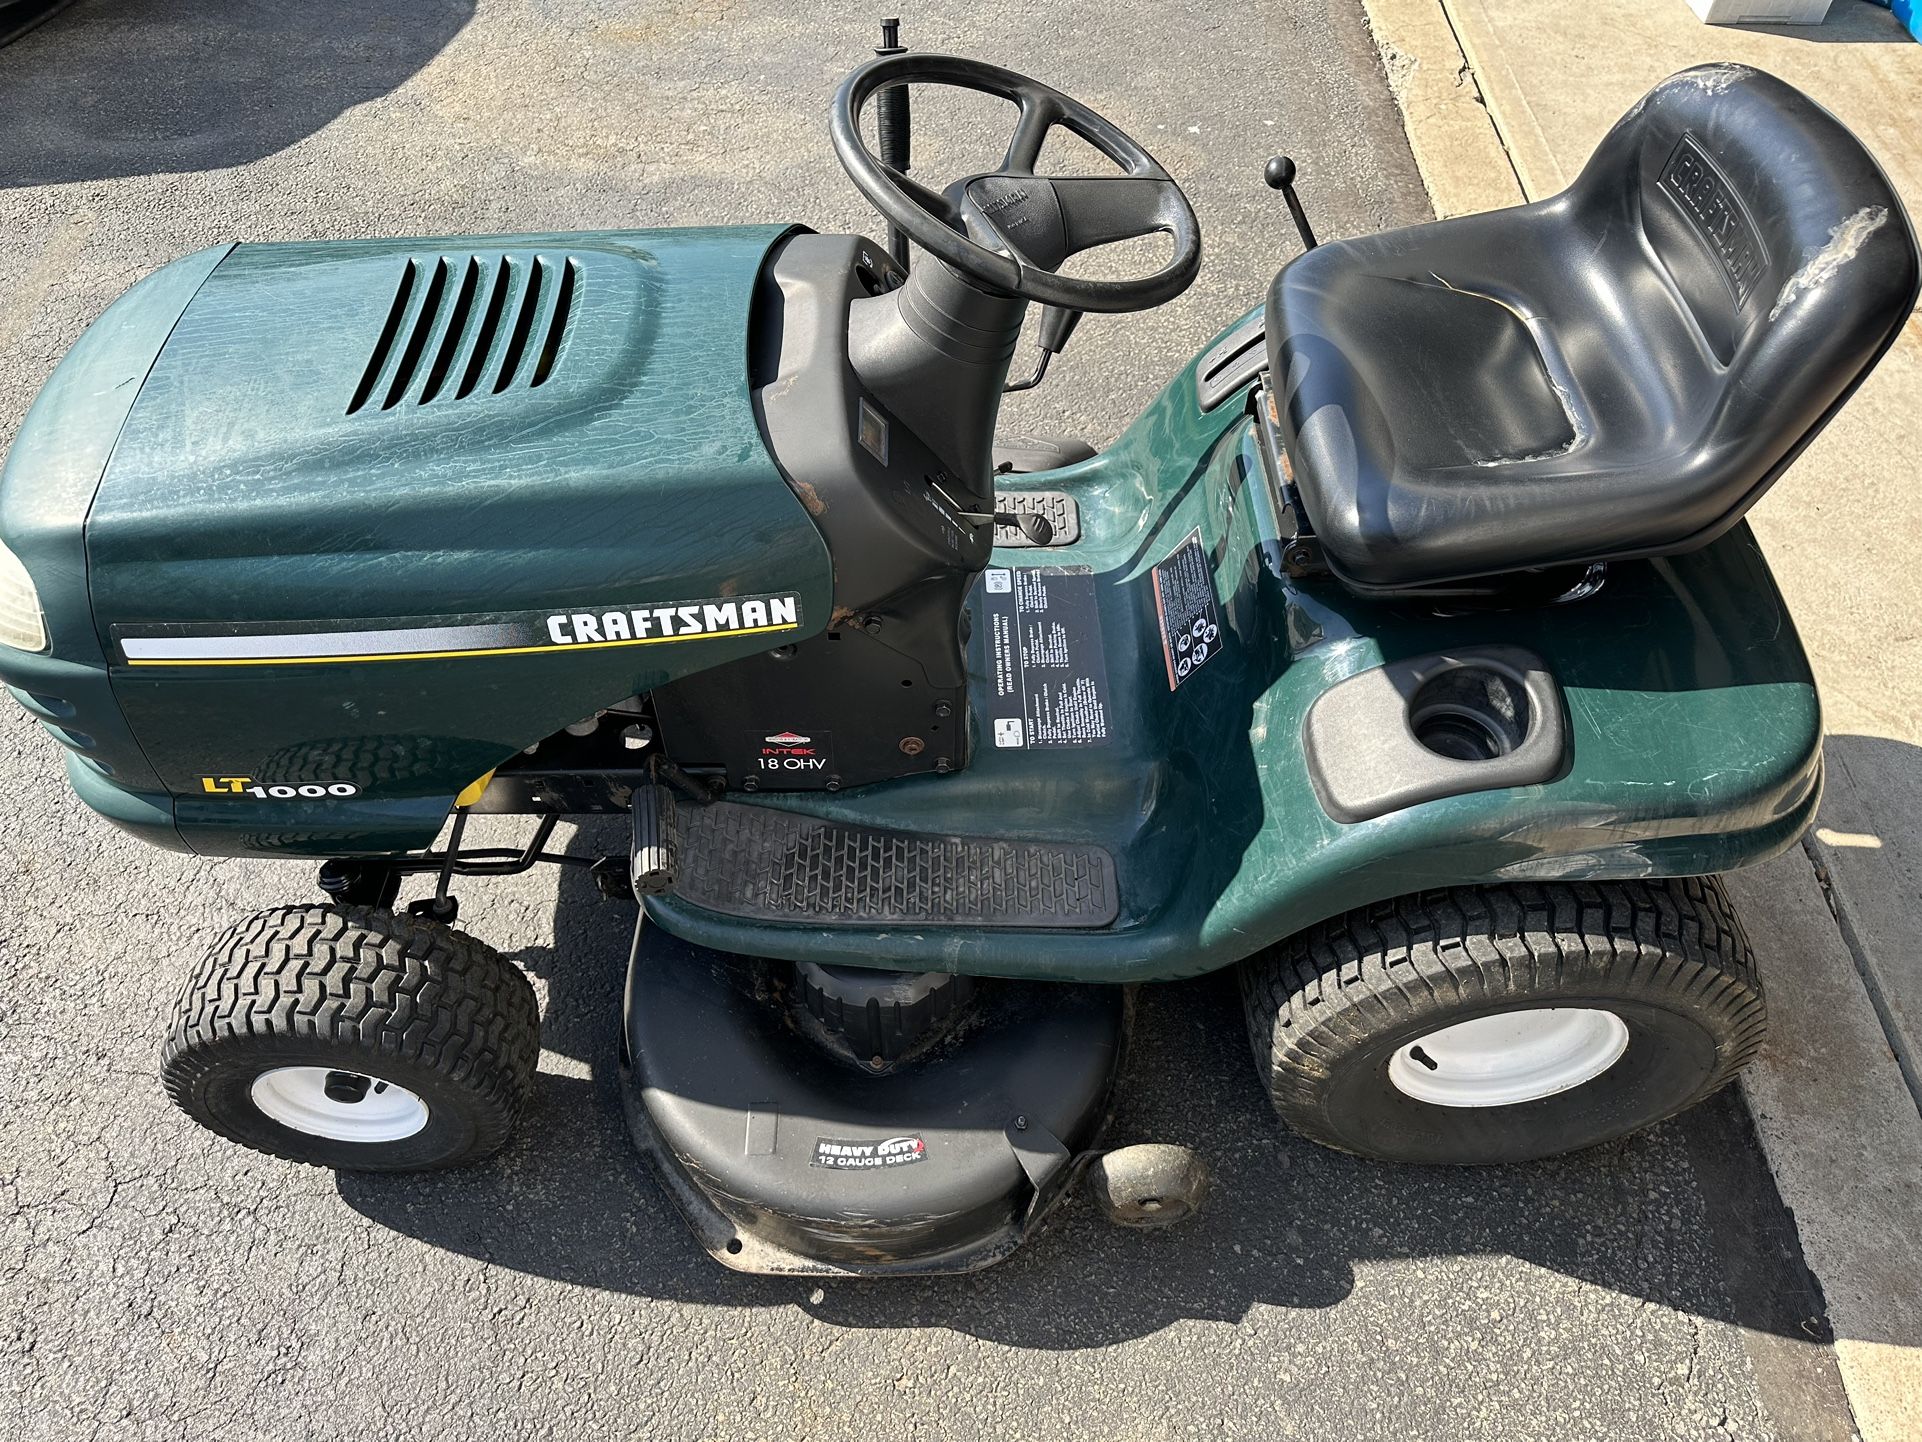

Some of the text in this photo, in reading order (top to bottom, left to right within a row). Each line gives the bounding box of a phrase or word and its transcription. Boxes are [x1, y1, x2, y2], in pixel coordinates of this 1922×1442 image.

[547, 597, 798, 645] CRAFTSMAN
[993, 613, 1005, 696] OPERATING INSTRUCTIONS
[1002, 616, 1014, 693] (READ OWNERS MANUAL)
[758, 758, 827, 770] 18 OHV
[819, 1140, 921, 1157] HEAVY DUTY
[819, 1152, 922, 1166] 12 GAUGE DECK
